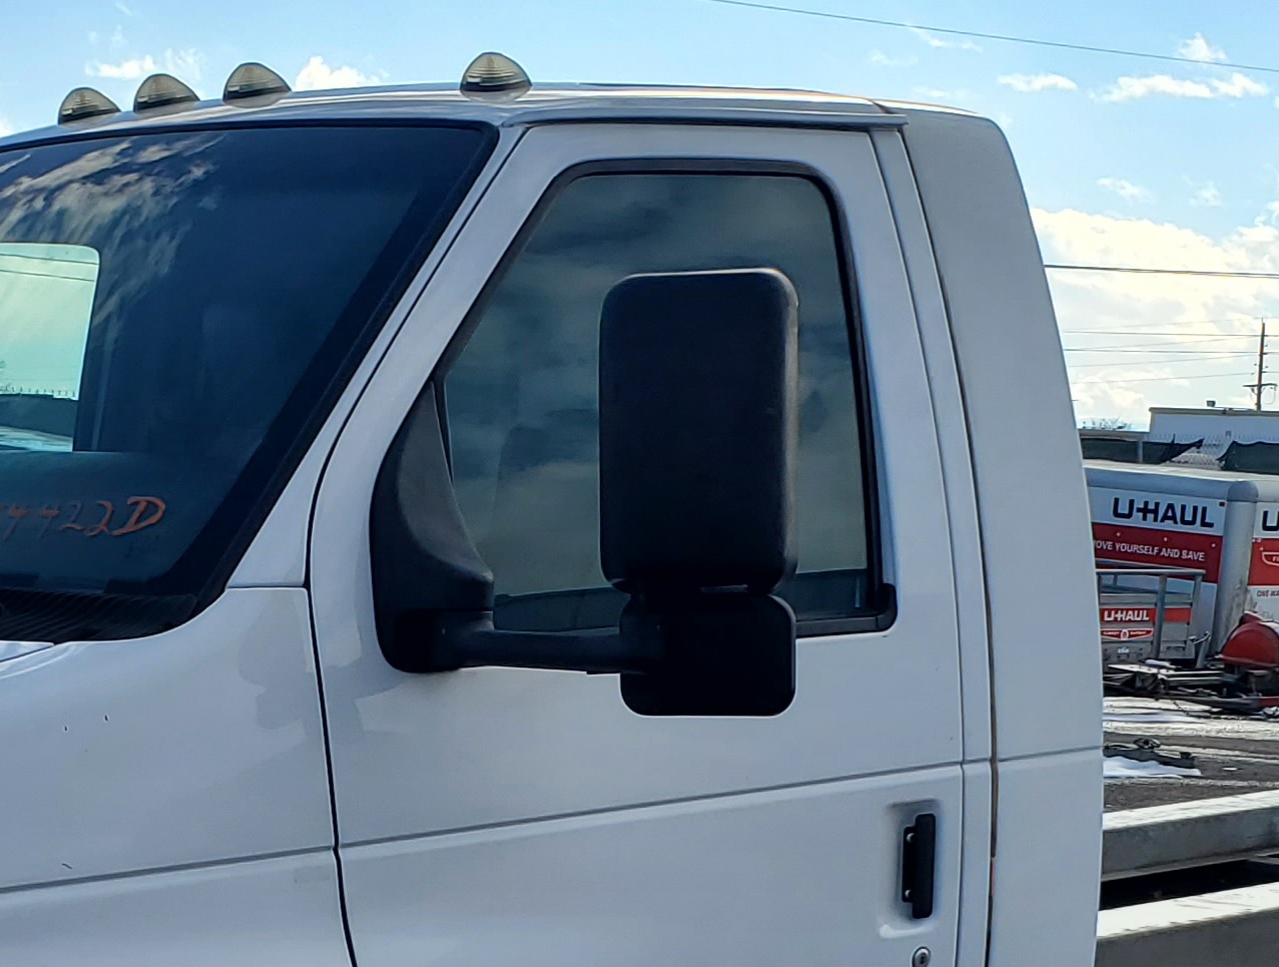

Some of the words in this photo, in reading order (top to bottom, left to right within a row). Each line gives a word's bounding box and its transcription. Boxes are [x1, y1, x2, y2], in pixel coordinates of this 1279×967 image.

[1112, 497, 1215, 528] U-HAUL
[1096, 540, 1114, 550] OVE
[1115, 543, 1159, 556] YOURSELF
[1160, 548, 1181, 558] AND
[1181, 550, 1205, 561] SAVE
[1104, 610, 1150, 621] U-HAUL
